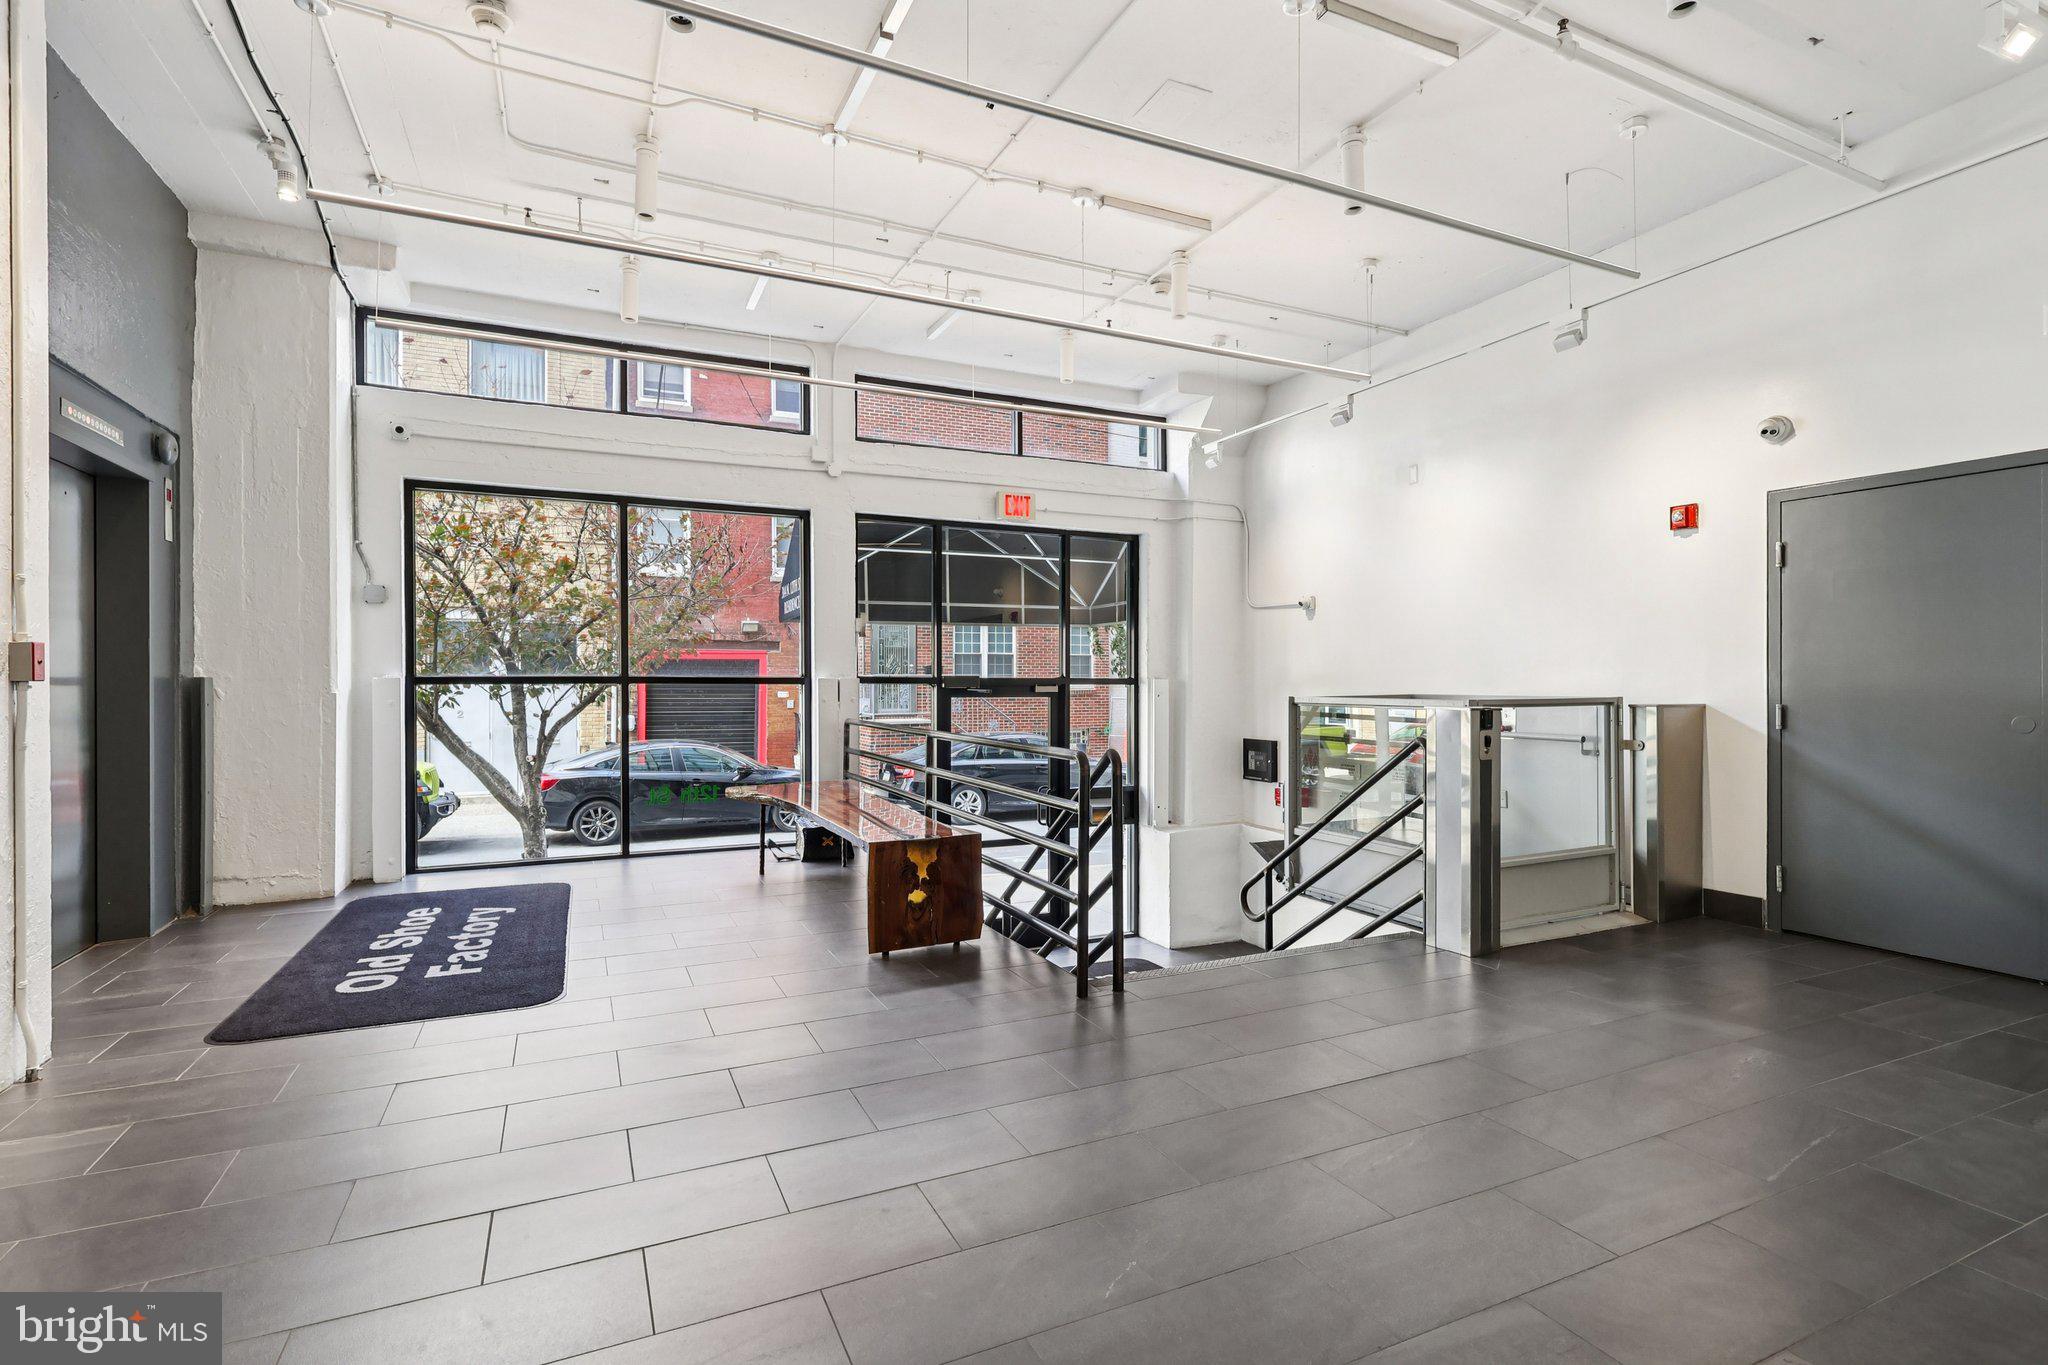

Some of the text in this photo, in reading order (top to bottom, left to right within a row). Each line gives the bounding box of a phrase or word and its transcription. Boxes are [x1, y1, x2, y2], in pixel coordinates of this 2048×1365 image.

[1005, 494, 1031, 517] EXIT
[335, 907, 443, 994] Old Shoe
[424, 907, 517, 978] Factory
